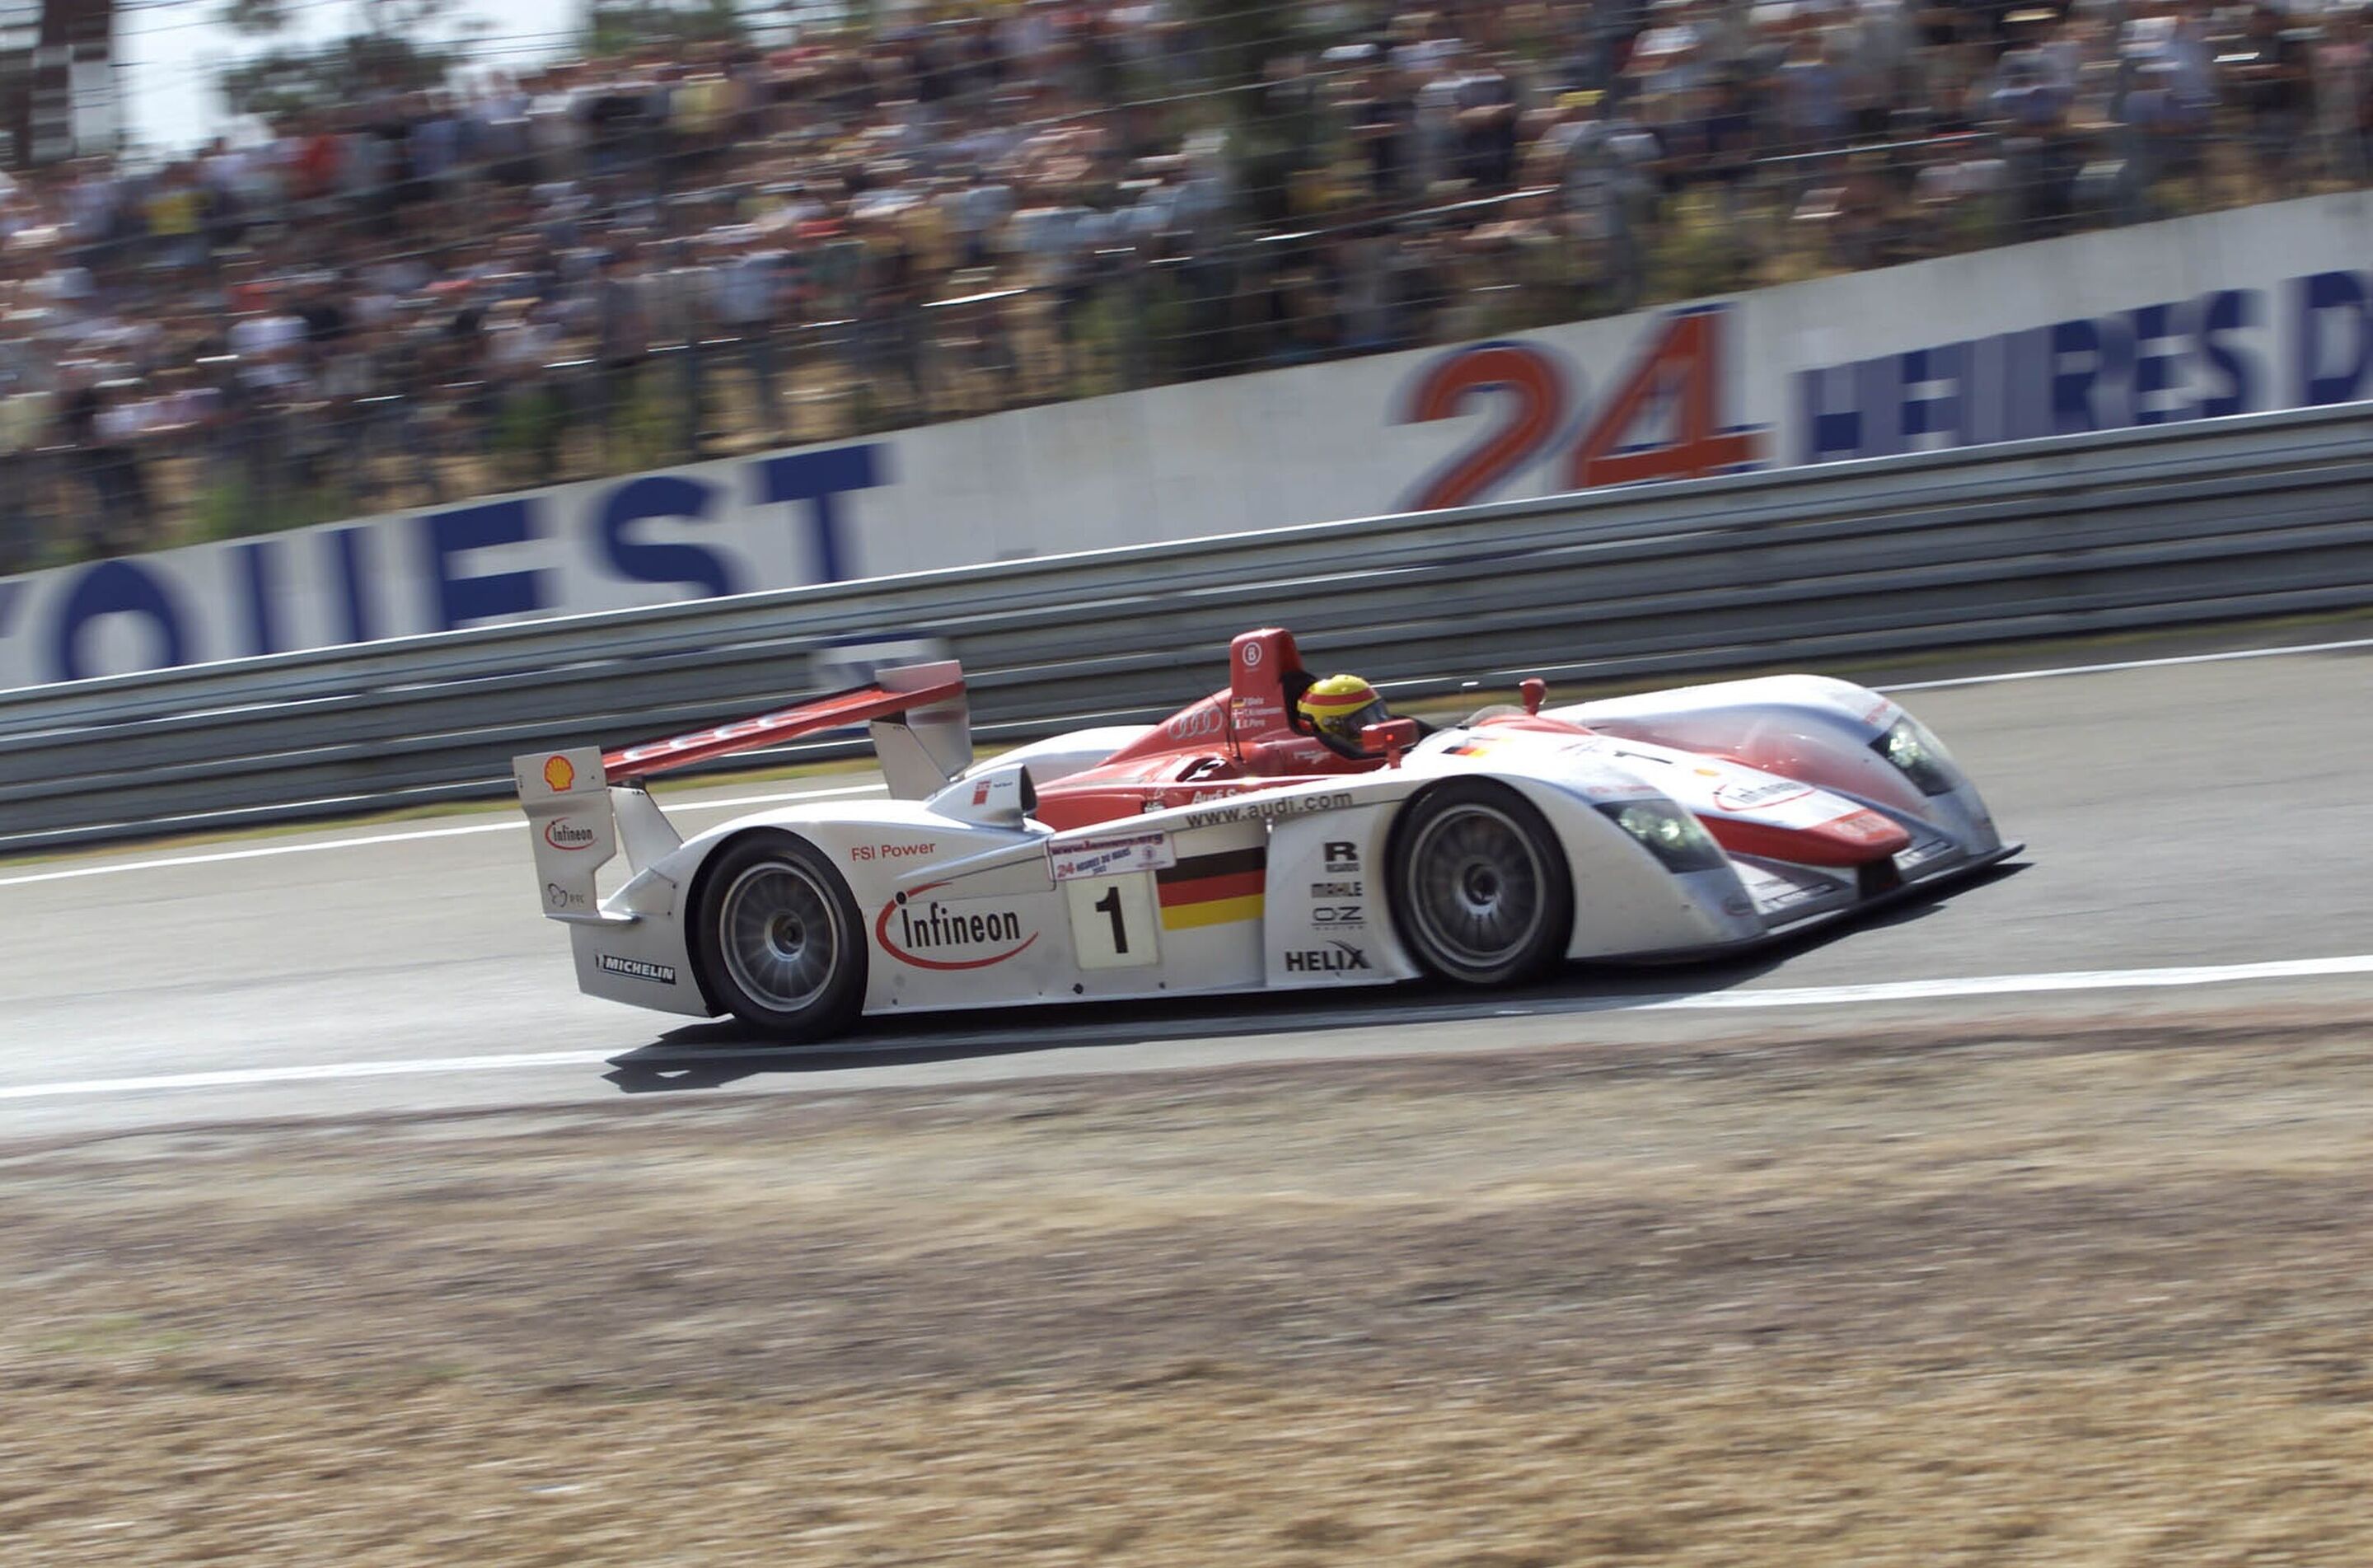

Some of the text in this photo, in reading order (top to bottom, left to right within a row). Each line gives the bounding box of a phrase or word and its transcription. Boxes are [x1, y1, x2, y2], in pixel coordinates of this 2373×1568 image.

[1386, 302, 1776, 511] 24
[1186, 791, 1353, 828] www.audi.com
[551, 821, 593, 842] Infineon
[851, 842, 936, 862] FSI Power
[1324, 841, 1359, 862] R
[1056, 862, 1075, 879] 24
[895, 891, 1021, 948] Infineon
[1096, 887, 1128, 953] 1
[1313, 906, 1363, 921] OZ
[605, 957, 674, 981] MICHELIN
[1285, 947, 1372, 971] HELIX
